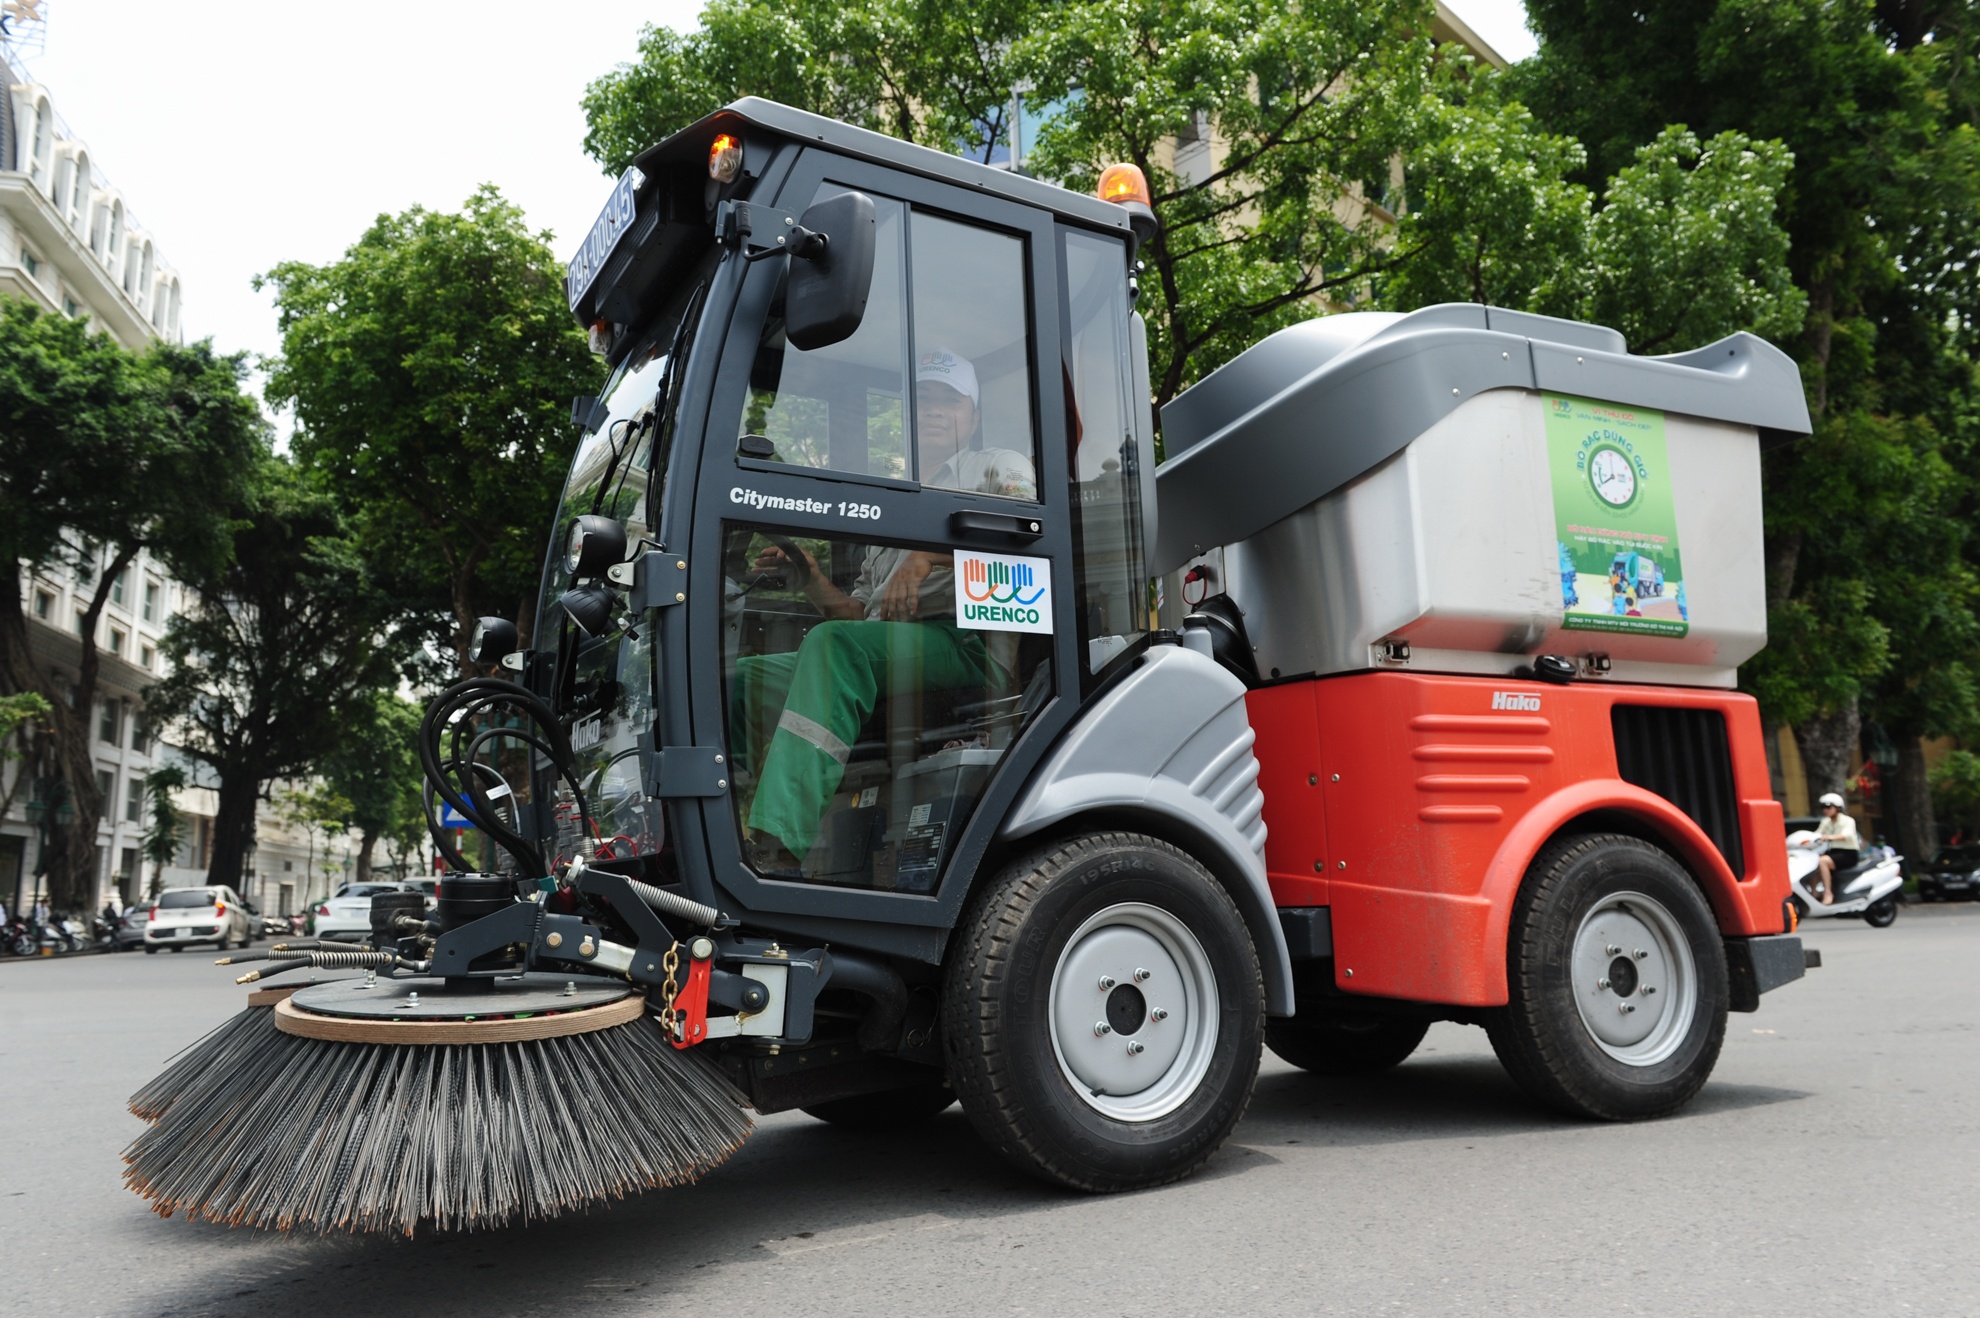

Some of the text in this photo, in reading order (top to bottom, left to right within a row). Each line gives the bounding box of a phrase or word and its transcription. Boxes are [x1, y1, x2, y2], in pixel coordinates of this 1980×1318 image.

[569, 176, 631, 304] 29A-000.45
[729, 487, 882, 520] Citymaster 1250
[964, 604, 1039, 624] URENCO
[1491, 691, 1541, 711] Hako
[571, 708, 602, 753] Hako
[1011, 926, 1048, 1031] TOUR
